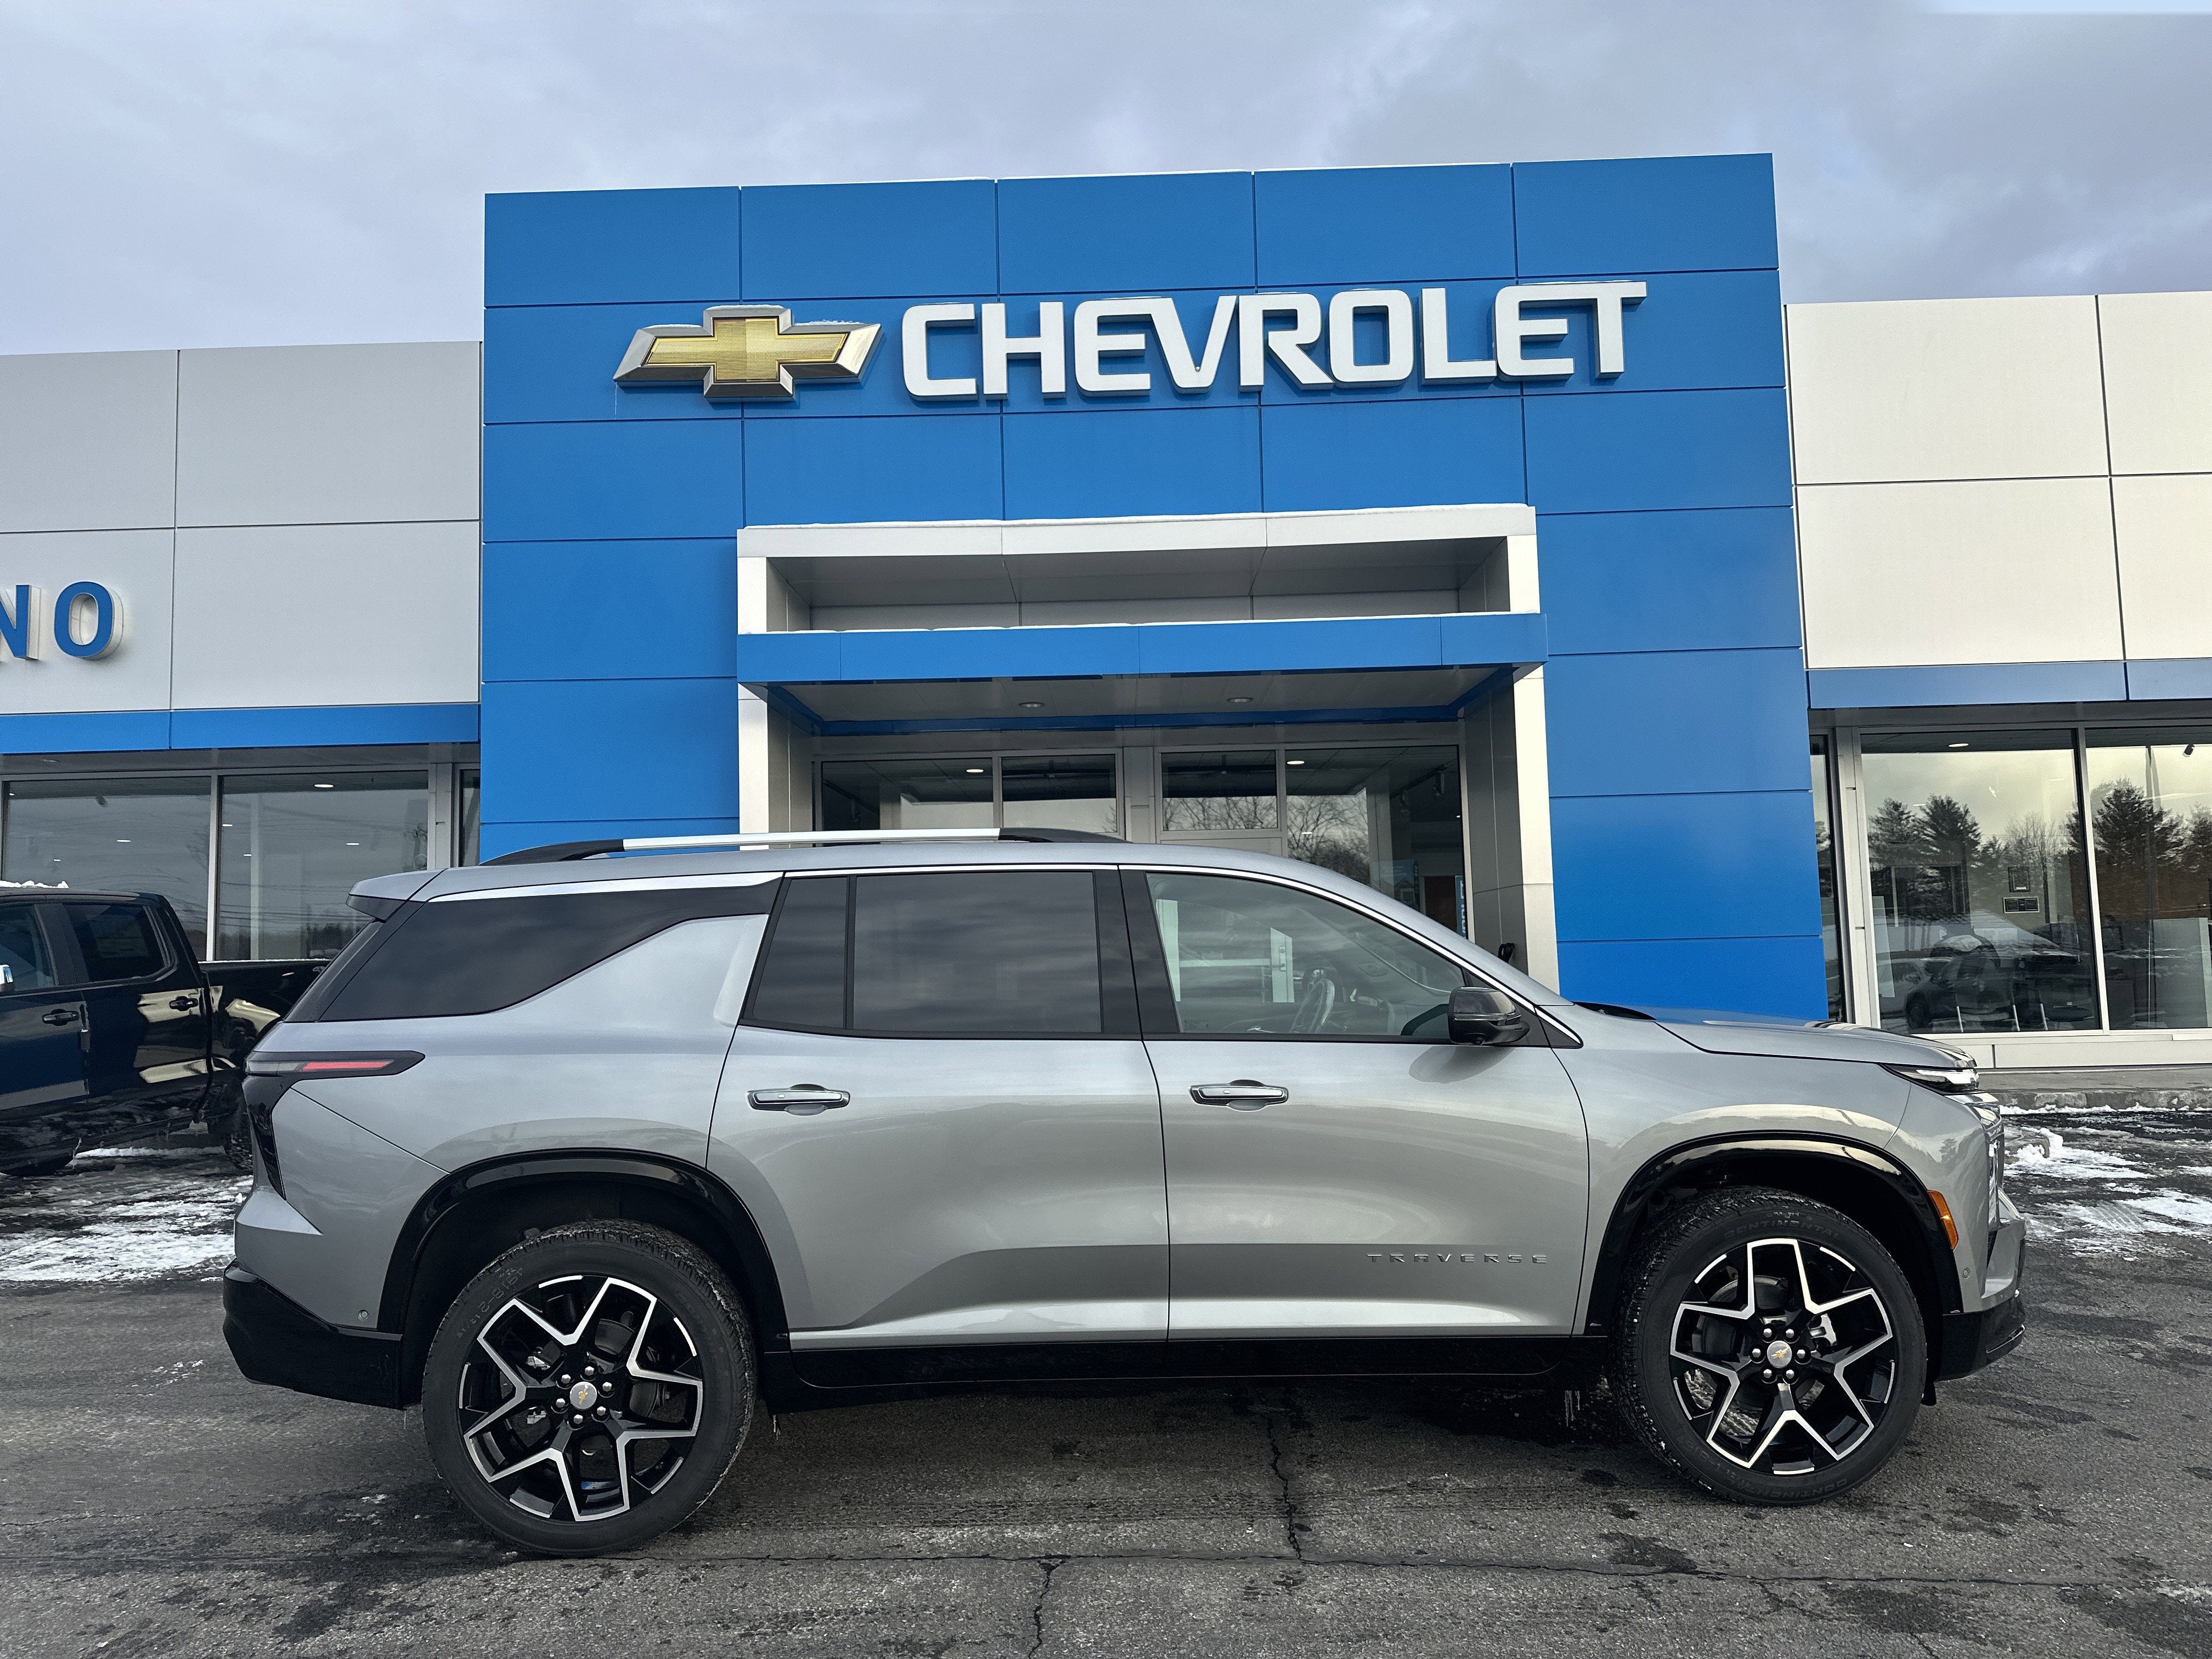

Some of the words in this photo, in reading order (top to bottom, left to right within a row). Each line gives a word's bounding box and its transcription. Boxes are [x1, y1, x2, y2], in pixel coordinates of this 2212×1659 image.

[901, 281, 1647, 402] CHEVROLET
[1724, 1220, 1839, 1240] CONTINENTAL
[1367, 1254, 1547, 1263] TRAVERSE
